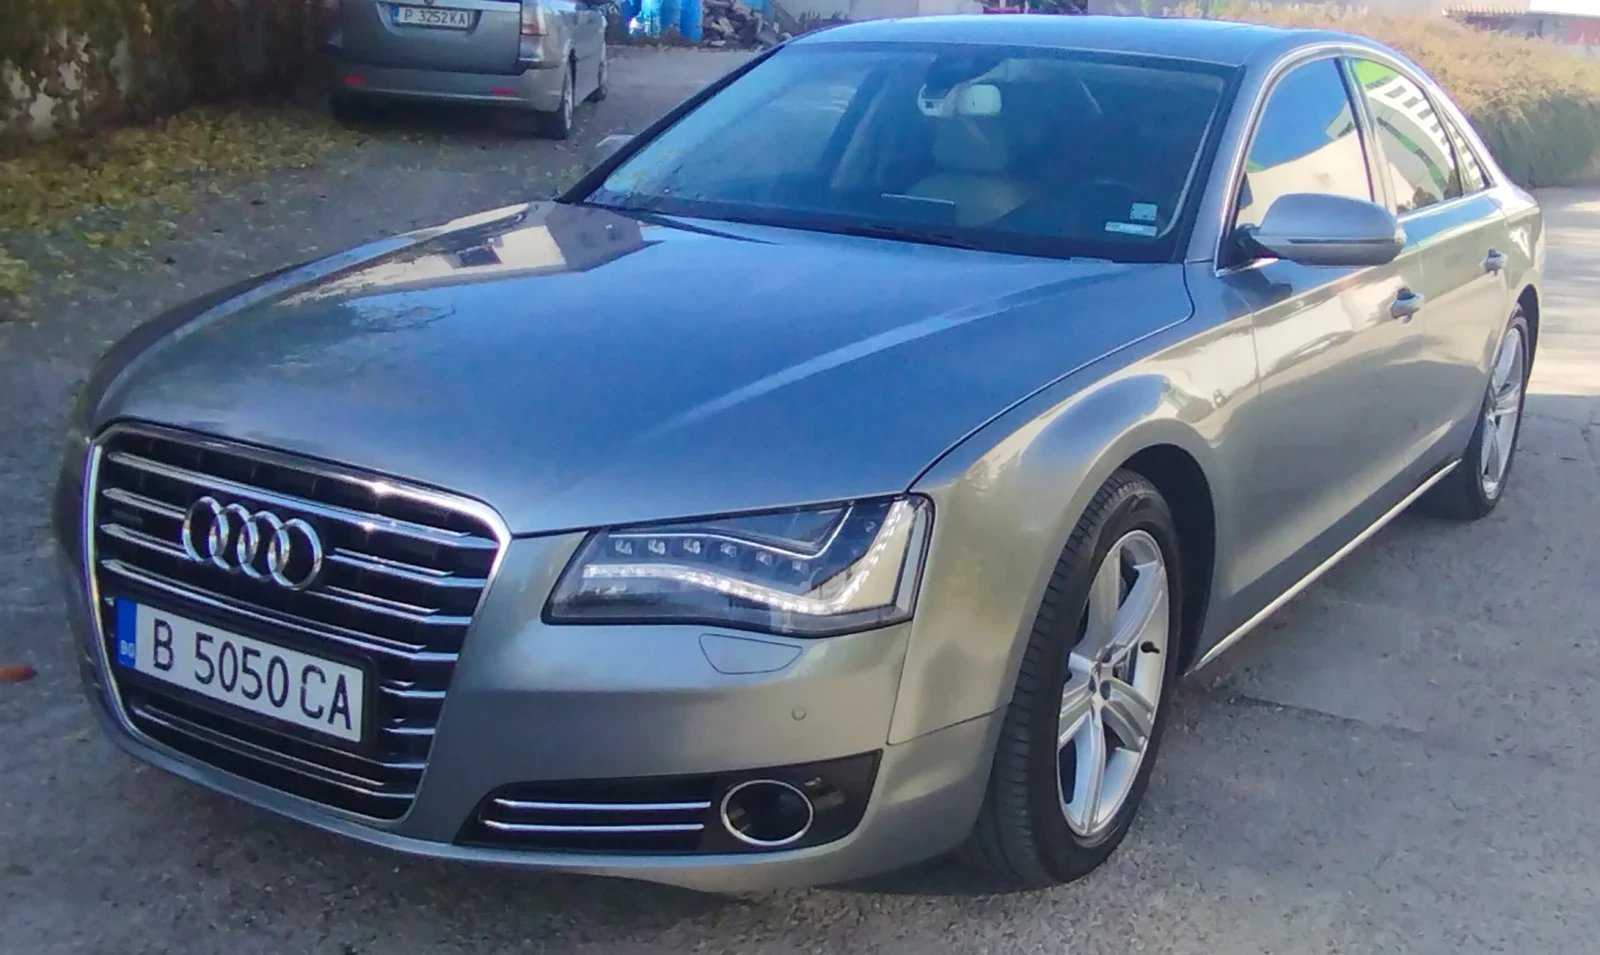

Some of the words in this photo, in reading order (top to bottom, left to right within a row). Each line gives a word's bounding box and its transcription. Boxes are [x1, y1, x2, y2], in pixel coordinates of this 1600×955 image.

[404, 9, 413, 21] P
[153, 617, 175, 672] B
[194, 631, 290, 708] 5050
[300, 663, 353, 731] CA
